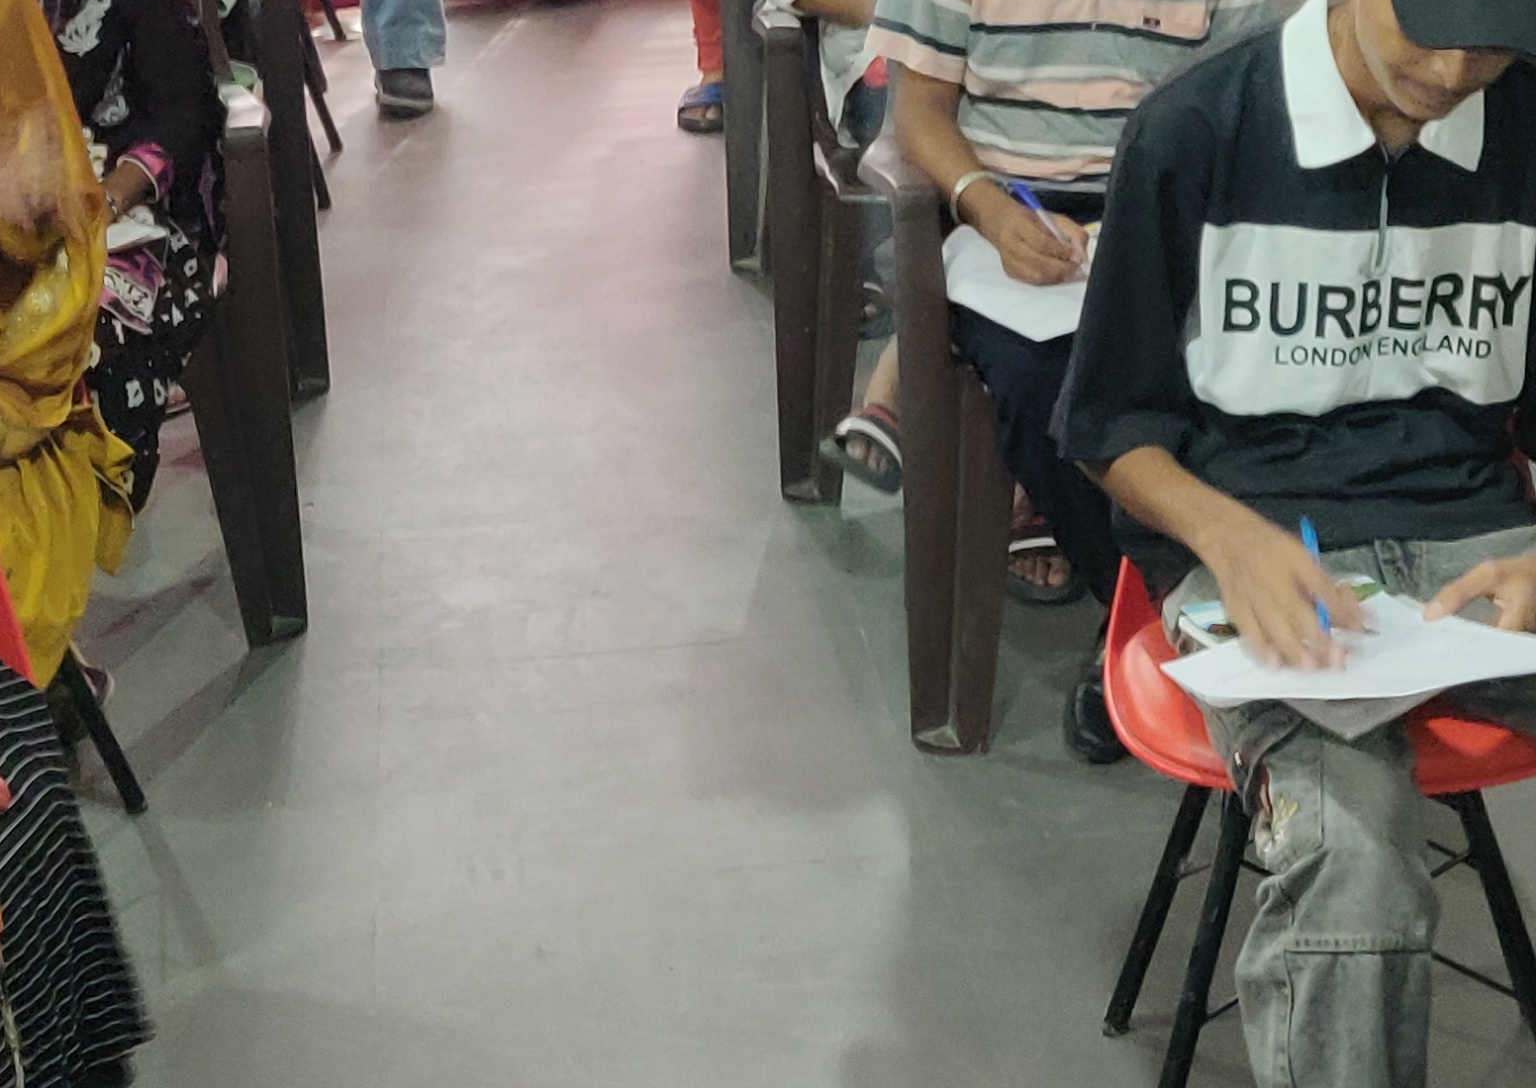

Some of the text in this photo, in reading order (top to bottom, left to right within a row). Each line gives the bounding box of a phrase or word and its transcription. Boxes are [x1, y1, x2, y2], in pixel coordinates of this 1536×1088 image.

[1222, 272, 1532, 340] BURBERRY
[1274, 333, 1493, 368] LONDON ENGLAND
